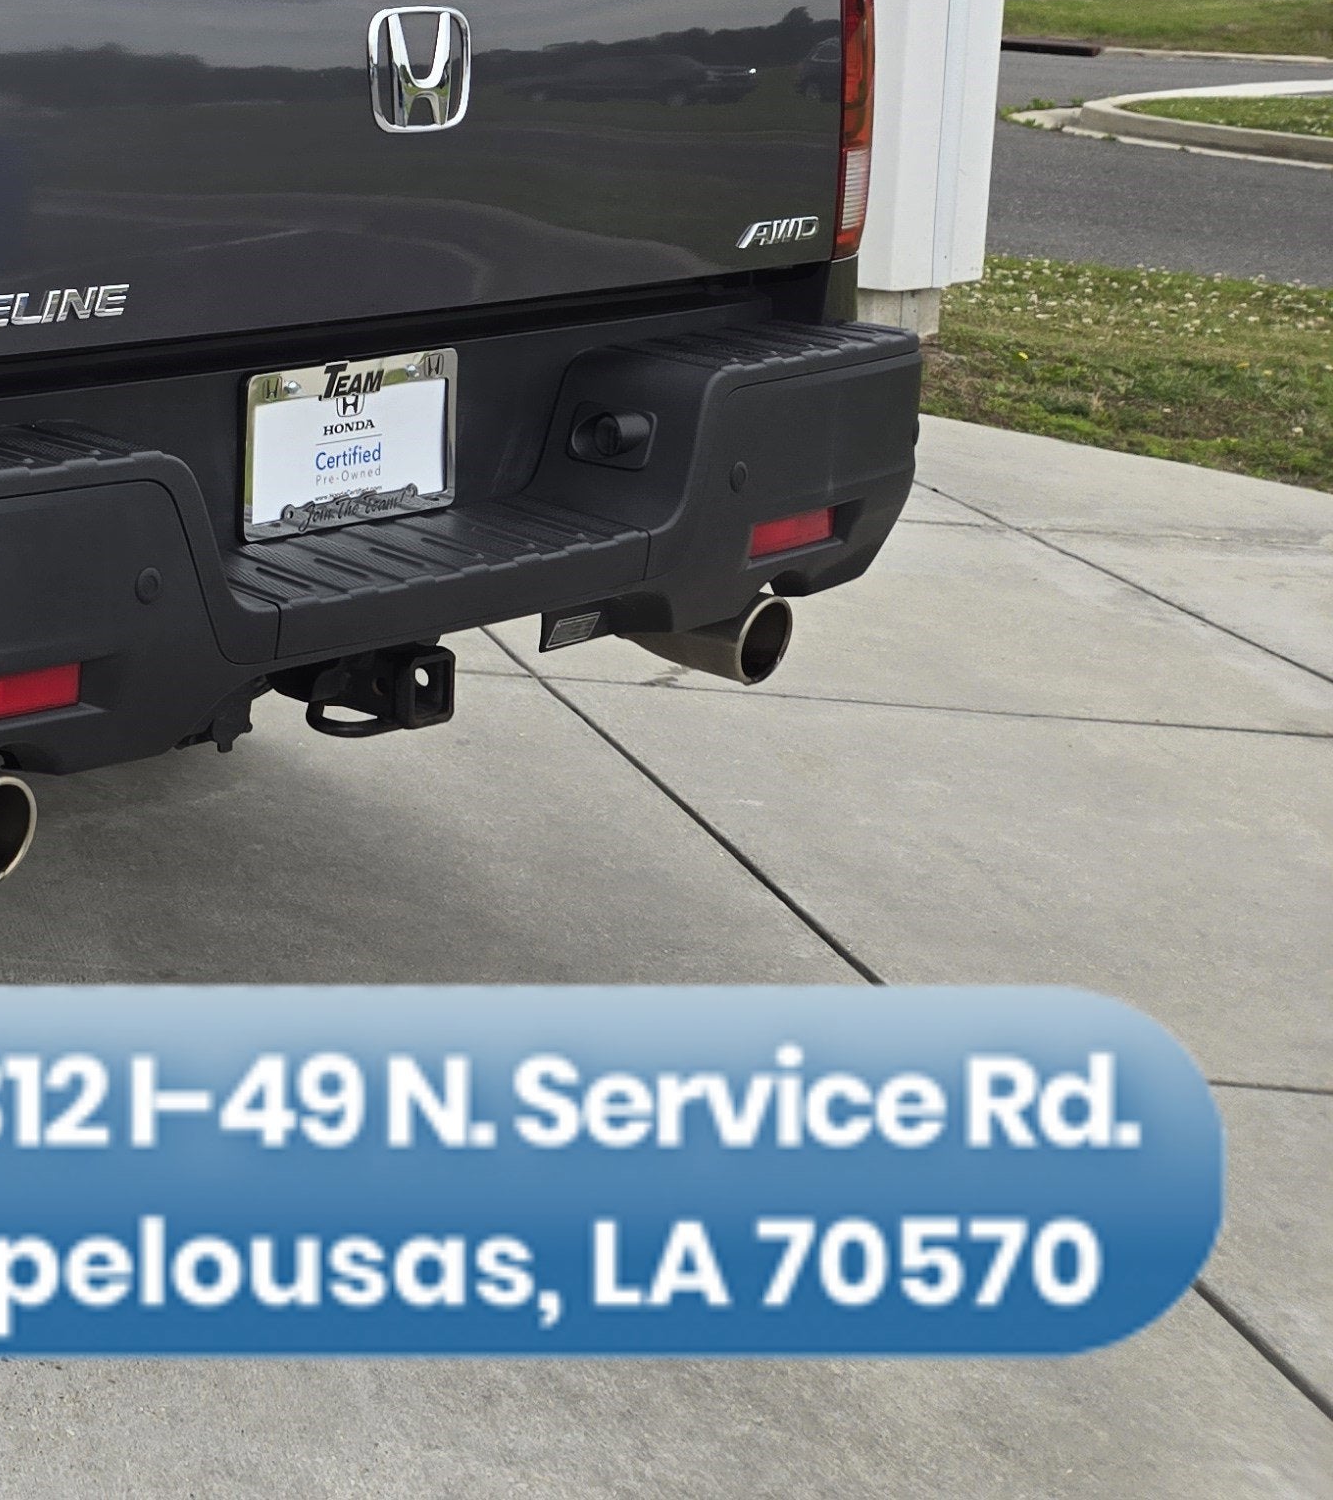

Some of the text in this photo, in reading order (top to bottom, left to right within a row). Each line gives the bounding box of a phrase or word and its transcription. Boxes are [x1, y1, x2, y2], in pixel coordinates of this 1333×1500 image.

[735, 215, 819, 249] AWD
[318, 362, 385, 402] TEAM
[322, 418, 376, 437] HONDA
[315, 442, 382, 471] Certified
[315, 466, 382, 487] Pre-Owned
[299, 501, 335, 533] Join
